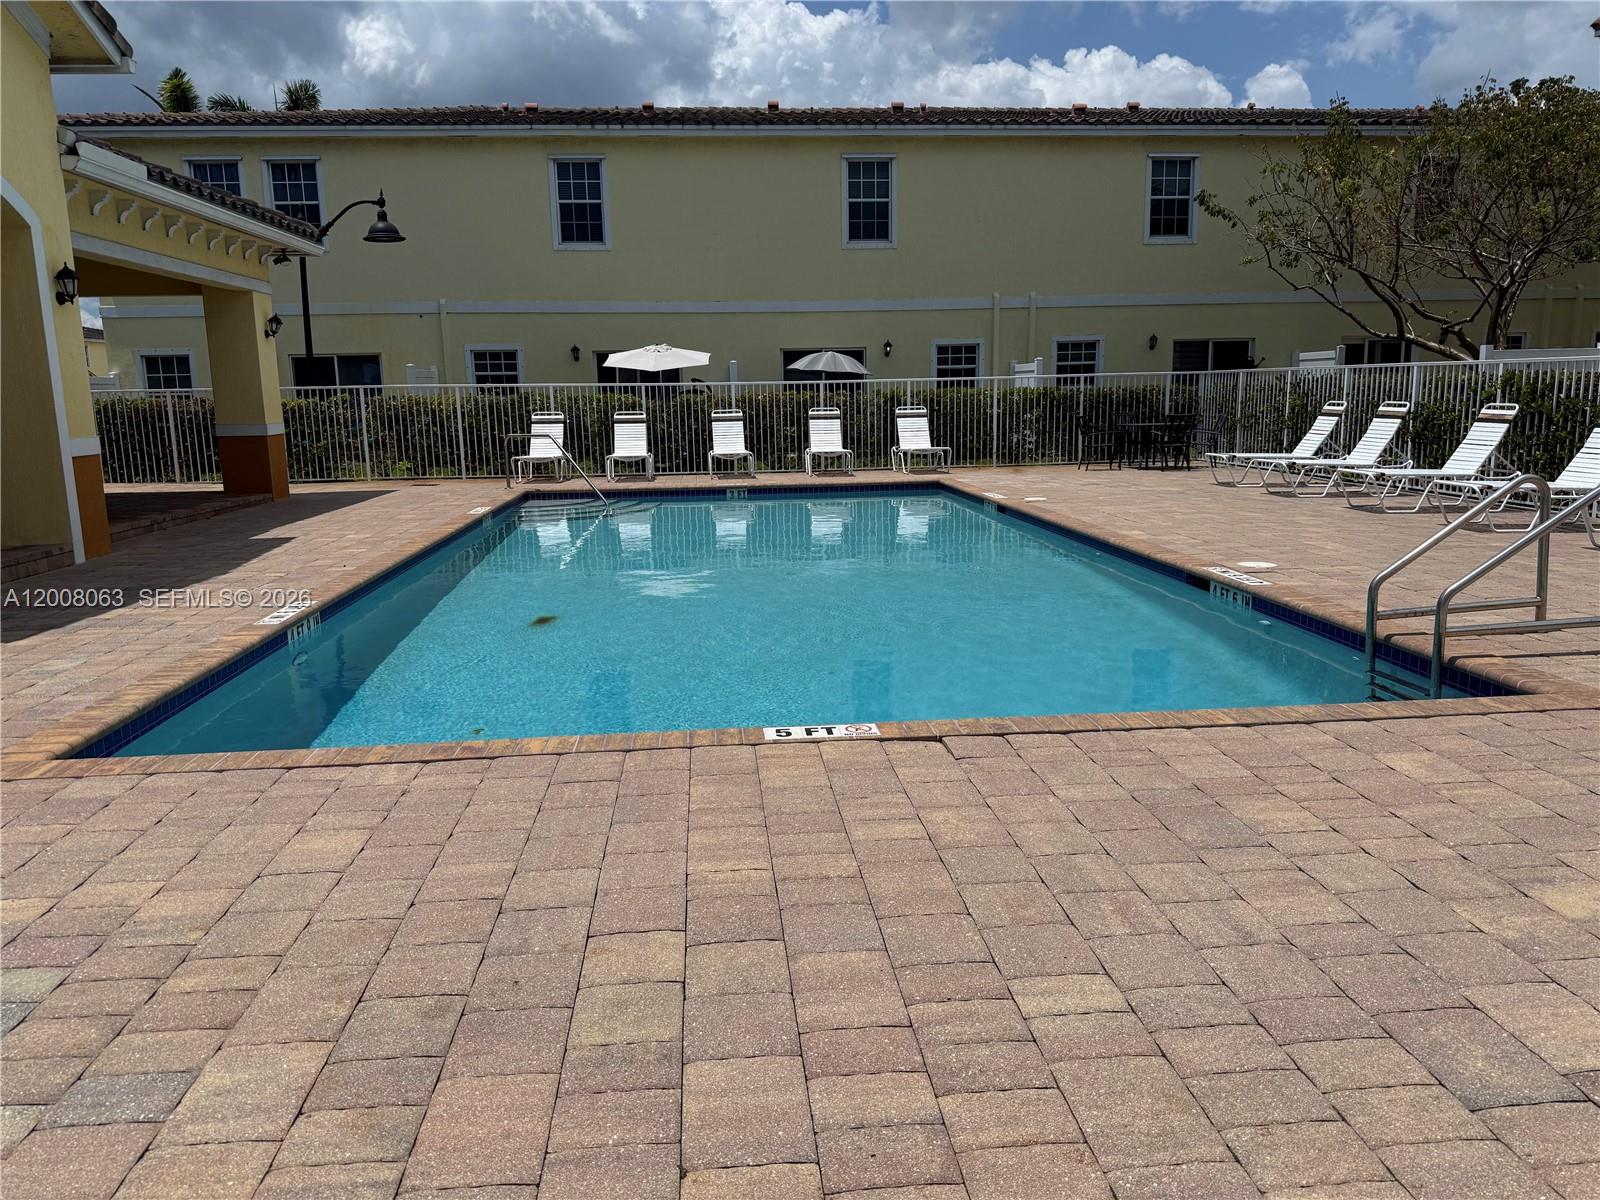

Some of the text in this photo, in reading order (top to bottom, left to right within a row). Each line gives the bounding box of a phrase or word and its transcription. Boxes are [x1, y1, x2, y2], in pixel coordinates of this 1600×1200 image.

[1220, 587, 1230, 600] FT
[775, 728, 793, 737] 5
[804, 726, 837, 736] FT
